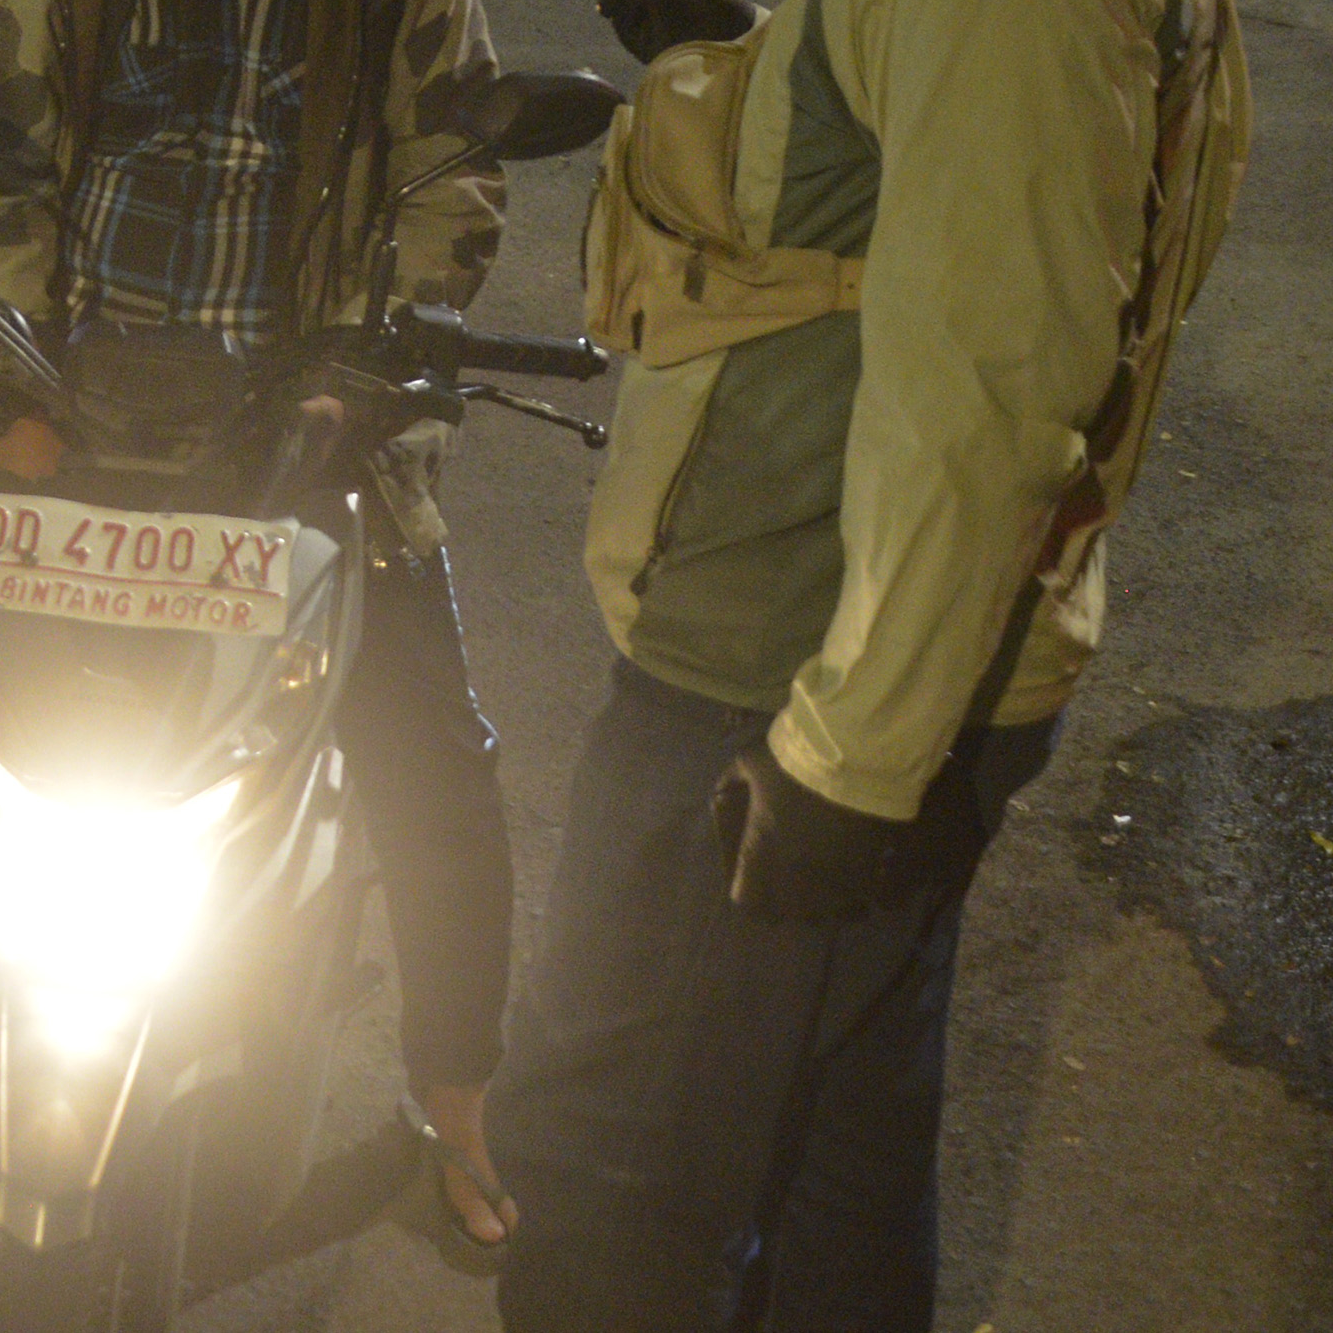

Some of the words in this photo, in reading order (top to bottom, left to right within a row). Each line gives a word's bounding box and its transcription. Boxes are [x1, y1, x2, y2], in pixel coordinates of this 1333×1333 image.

[63, 518, 195, 572] 4700
[213, 529, 282, 584] XY
[0, 577, 132, 616] BINTANG
[144, 593, 254, 629] MOTOR
